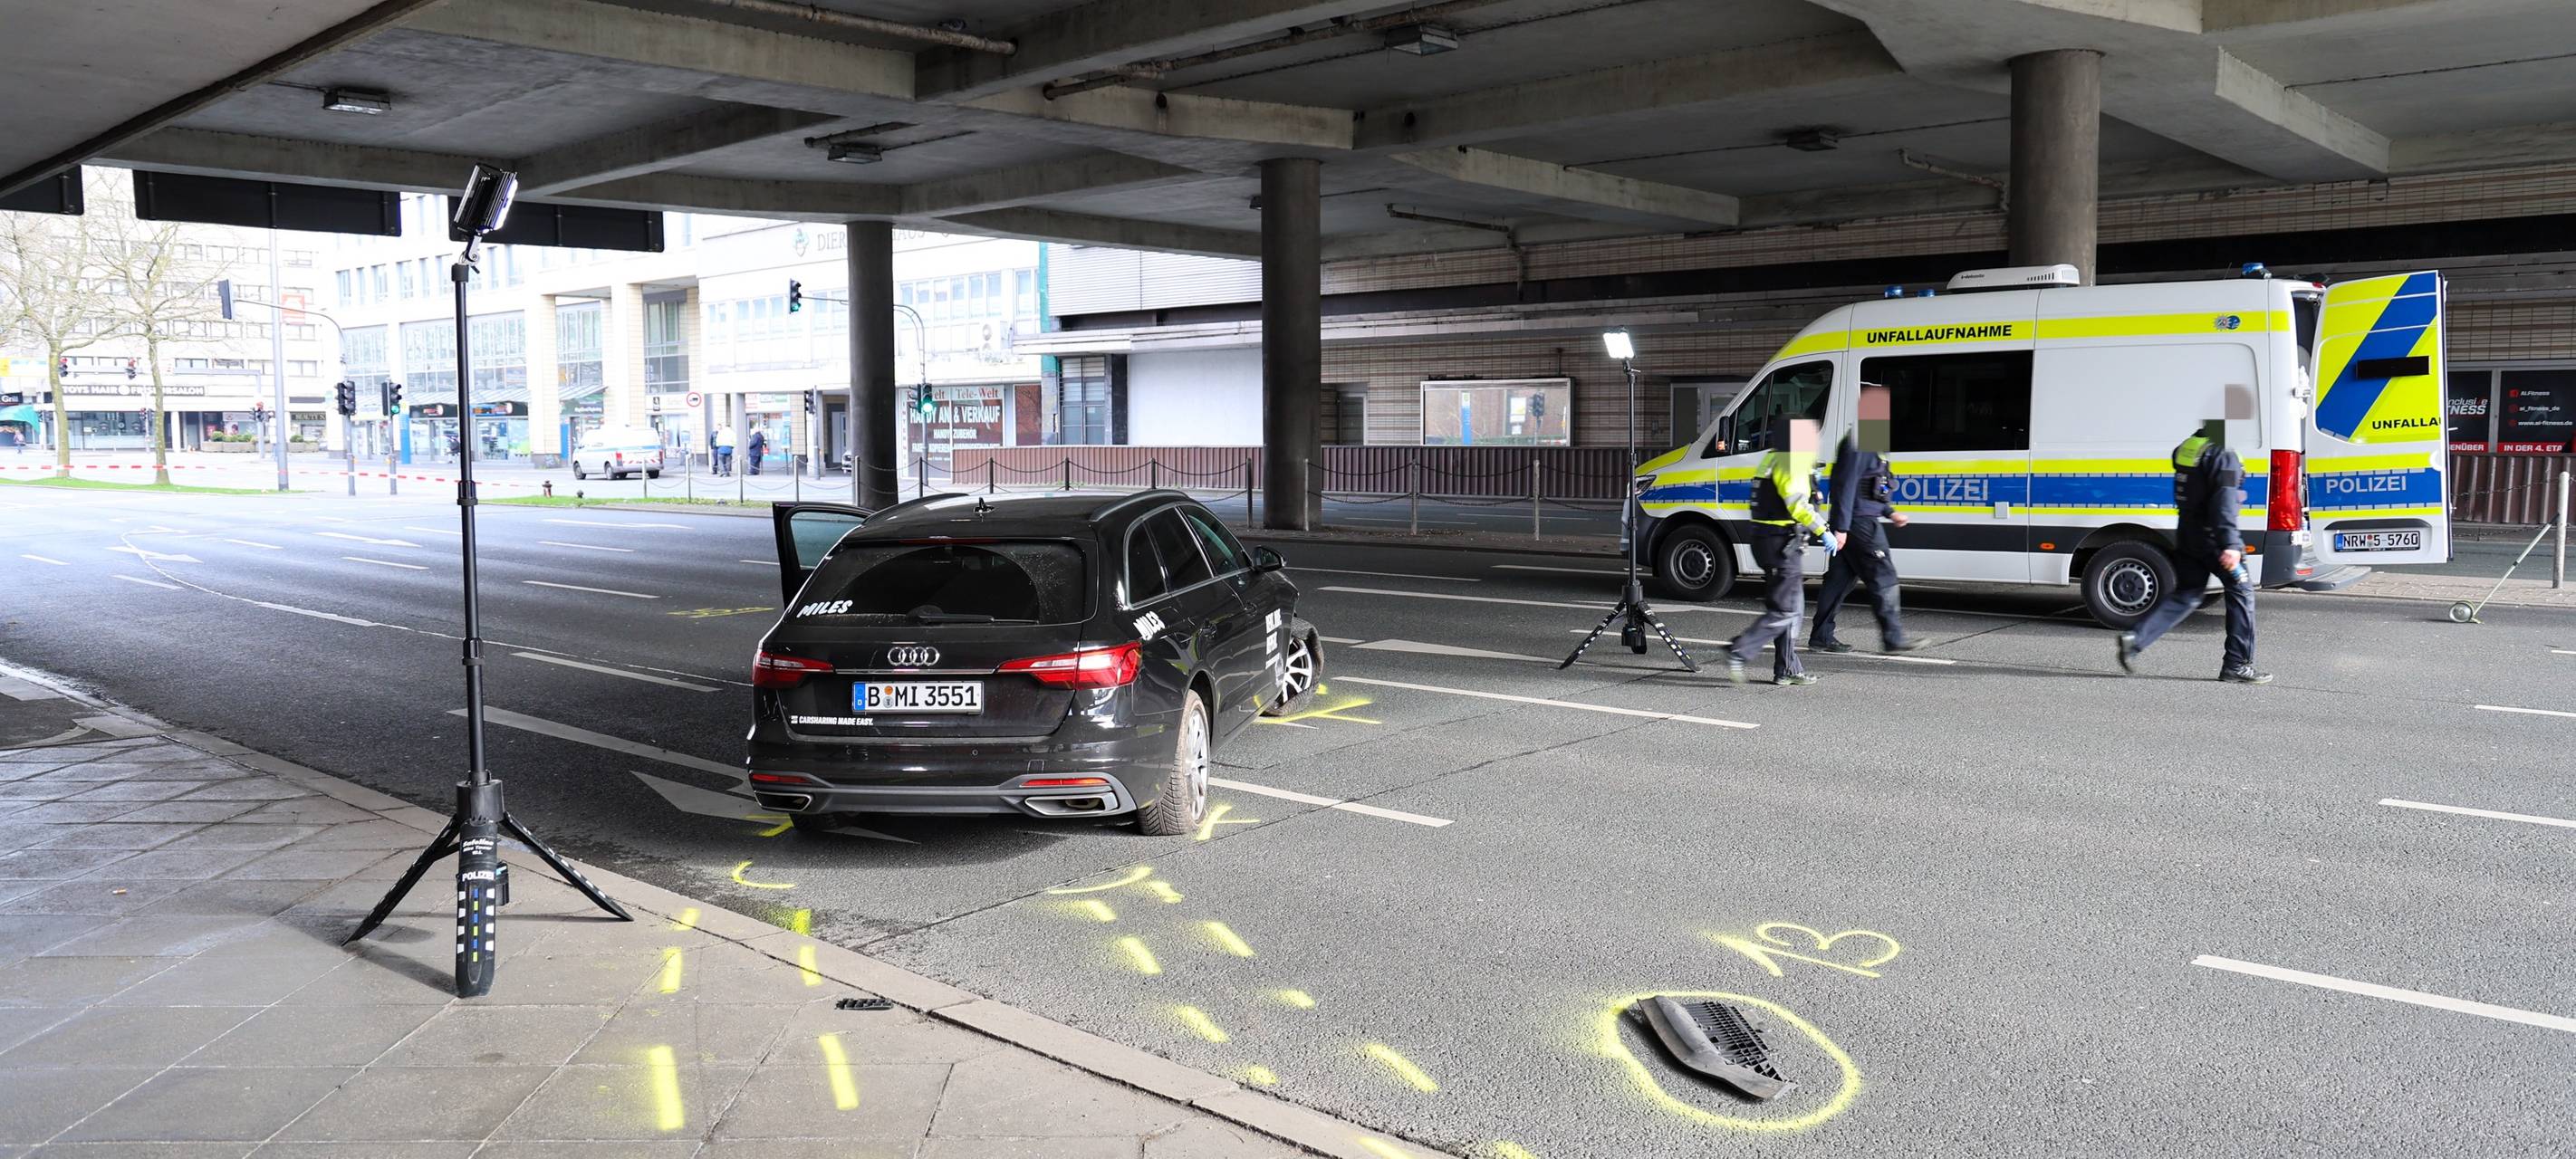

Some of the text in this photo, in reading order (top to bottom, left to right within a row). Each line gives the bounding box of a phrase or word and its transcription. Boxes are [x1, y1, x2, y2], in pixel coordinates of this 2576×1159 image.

[1867, 324, 2012, 343] UNFALLAUFNAHME
[130, 388, 204, 396] FRISRSALON
[955, 388, 998, 399] Tele-Welt
[1, 395, 19, 403] Grill
[2448, 398, 2488, 406] nclusive
[962, 406, 1000, 423] VERKAUF
[2448, 405, 2487, 415] NESS
[2372, 417, 2441, 429] UNFALLA
[2449, 443, 2485, 451] ENÜBER
[2326, 475, 2407, 494] POLIZEI
[2343, 535, 2366, 548] NRW
[796, 600, 853, 618] MILES
[868, 685, 977, 707] B MI 3551
[799, 715, 837, 725] CARSHARING
[838, 717, 856, 726] MADE
[856, 717, 874, 726] EASY.
[462, 870, 495, 882] POLIZEI
[1706, 922, 1901, 978] 13
